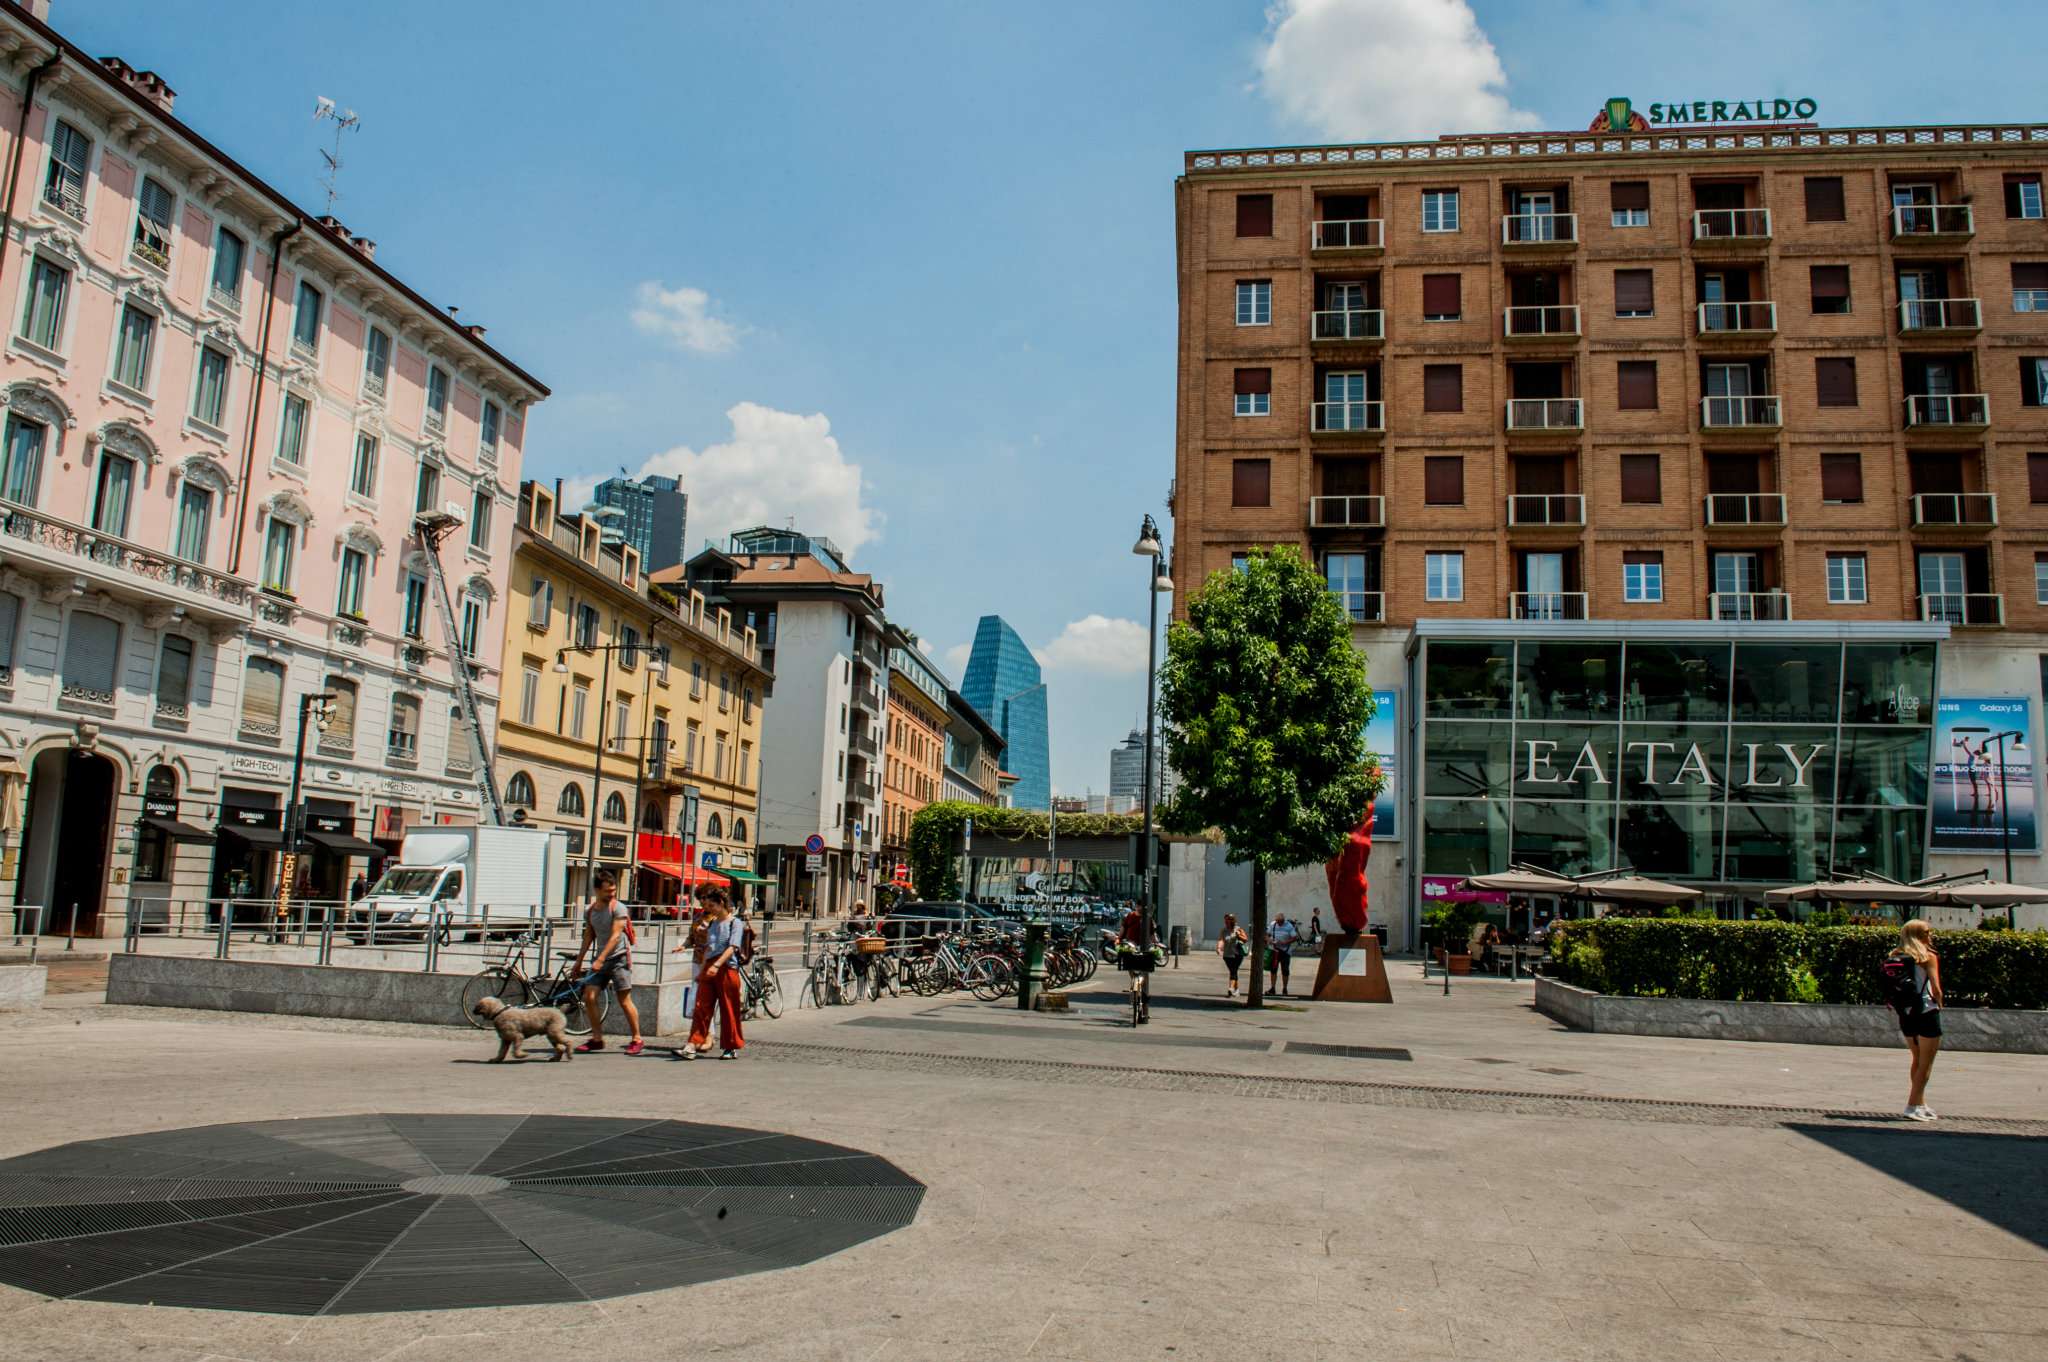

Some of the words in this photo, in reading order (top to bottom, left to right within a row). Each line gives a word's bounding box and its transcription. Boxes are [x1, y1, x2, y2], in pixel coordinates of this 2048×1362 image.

[1649, 97, 1817, 124] SMERALDO
[1980, 704, 2011, 712] Galaxy
[2012, 704, 2023, 712] S8
[236, 757, 279, 772] HIGH-TECH
[1521, 740, 1829, 787] EATALY
[384, 781, 416, 793] HIGH-TECH
[147, 802, 176, 812] DAMMANN
[278, 854, 296, 916] HIGH-TECH
[1001, 903, 1020, 912] TEL.
